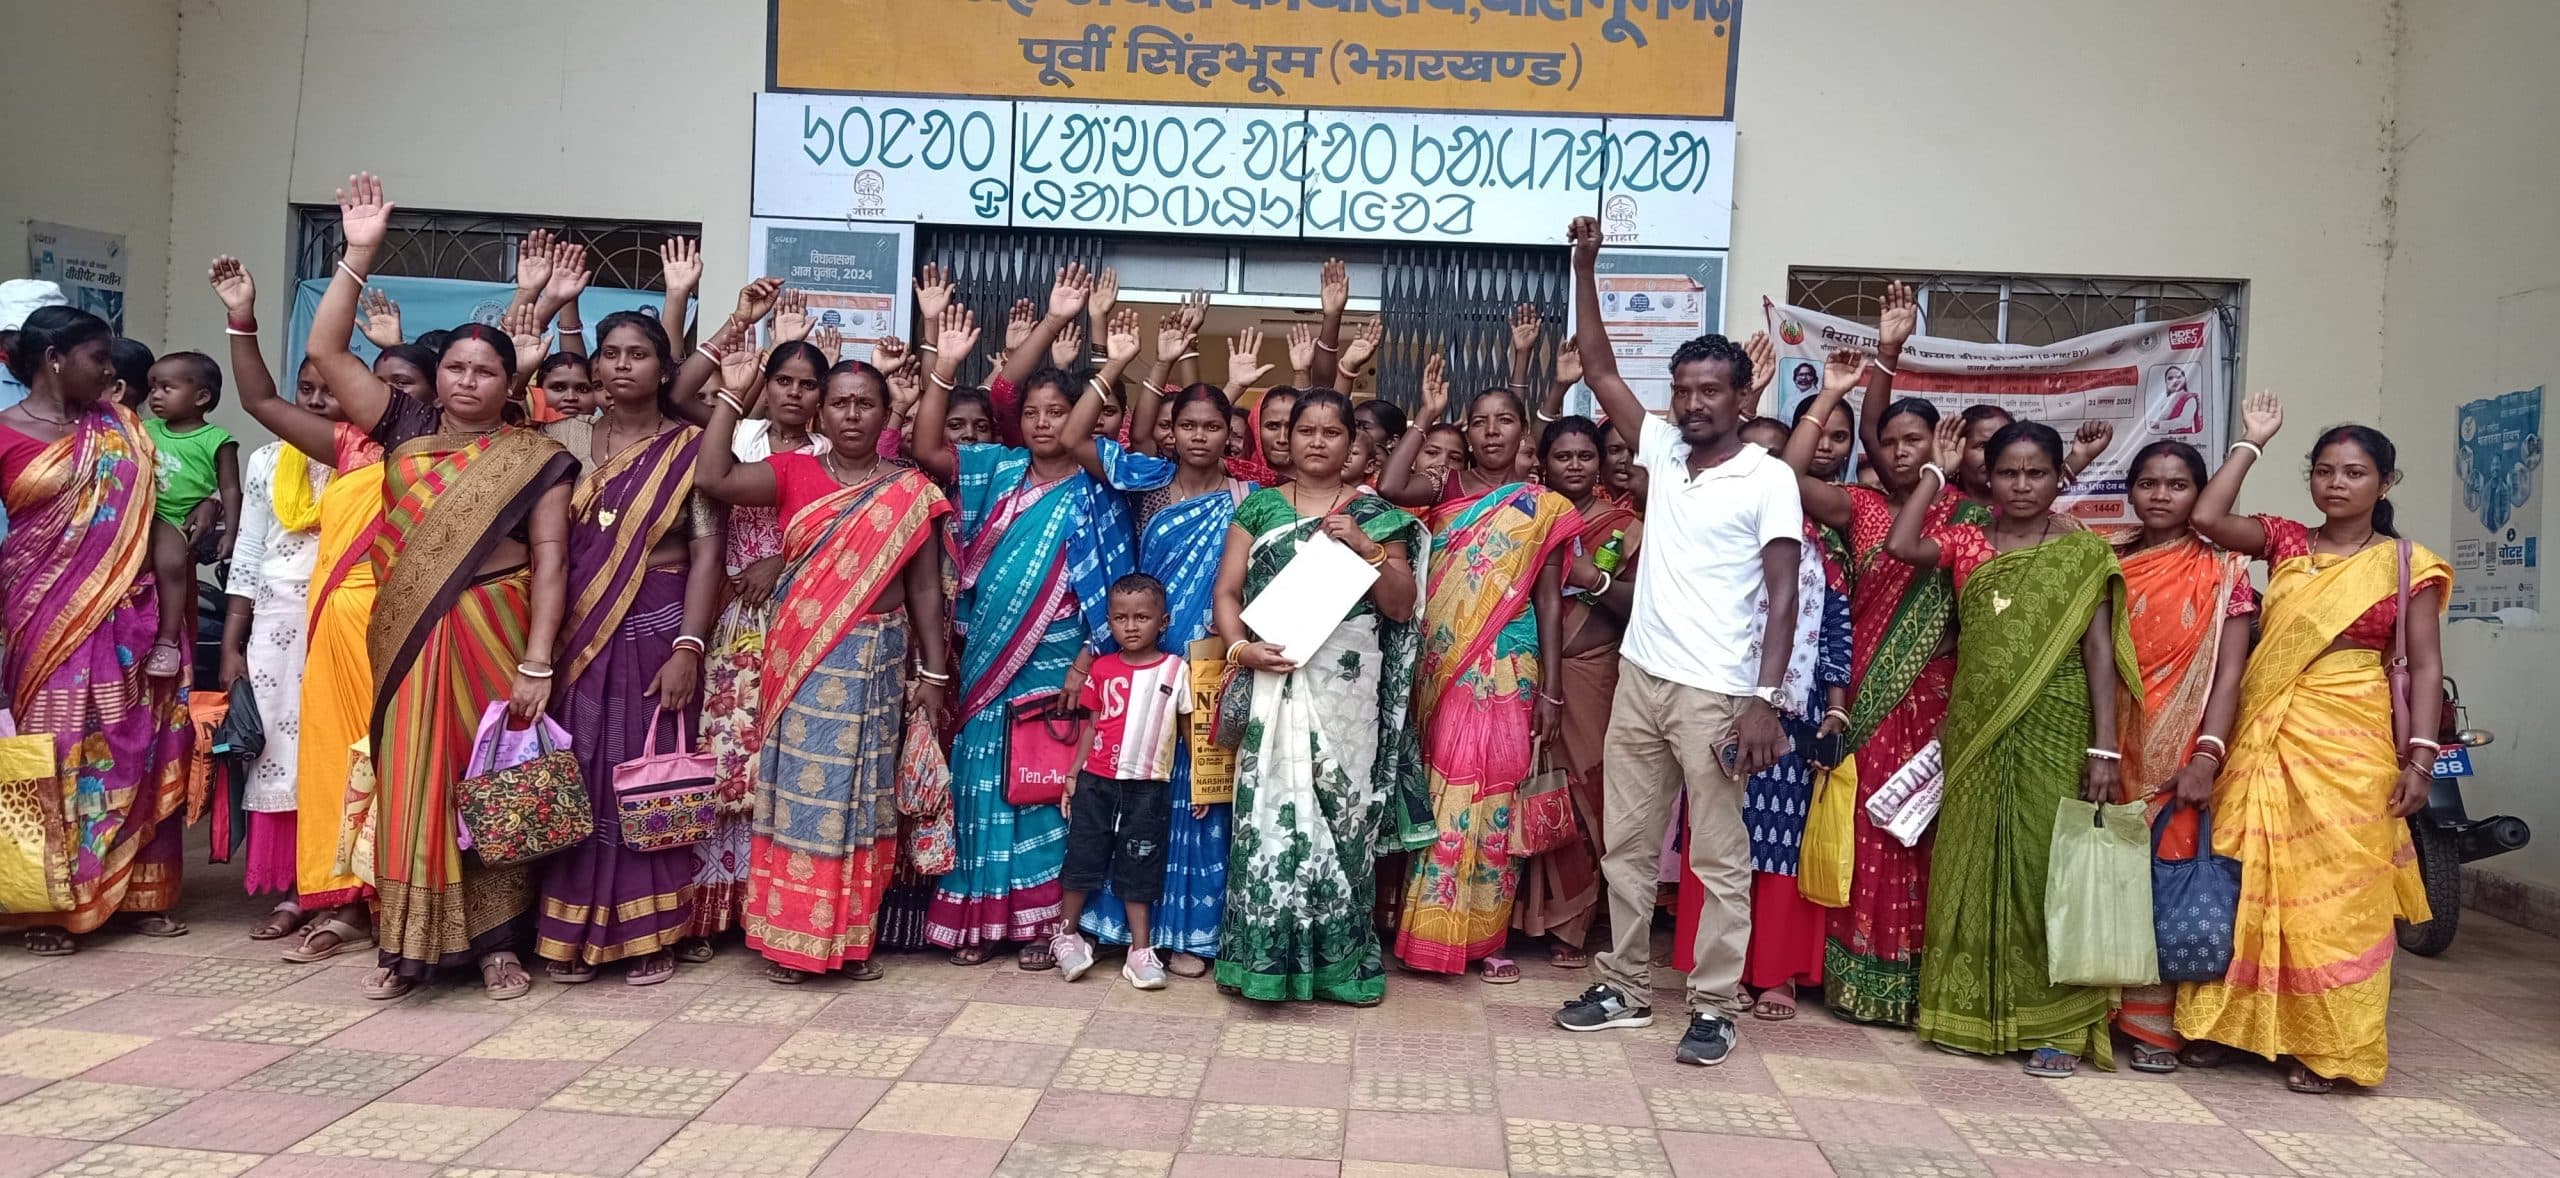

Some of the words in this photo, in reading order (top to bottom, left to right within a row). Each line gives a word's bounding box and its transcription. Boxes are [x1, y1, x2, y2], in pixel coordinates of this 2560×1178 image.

[1018, 24, 1116, 88] पूर्वी
[1124, 25, 1323, 96] सिंहभूम
[1330, 39, 1583, 91] (झारखण्ड)
[810, 249, 856, 266] विधानसभा
[791, 266, 811, 278] आम
[843, 268, 873, 281] 2024
[2170, 328, 2199, 338] HDFC
[2171, 336, 2197, 345] ERGO
[1019, 767, 1041, 784] Ten
